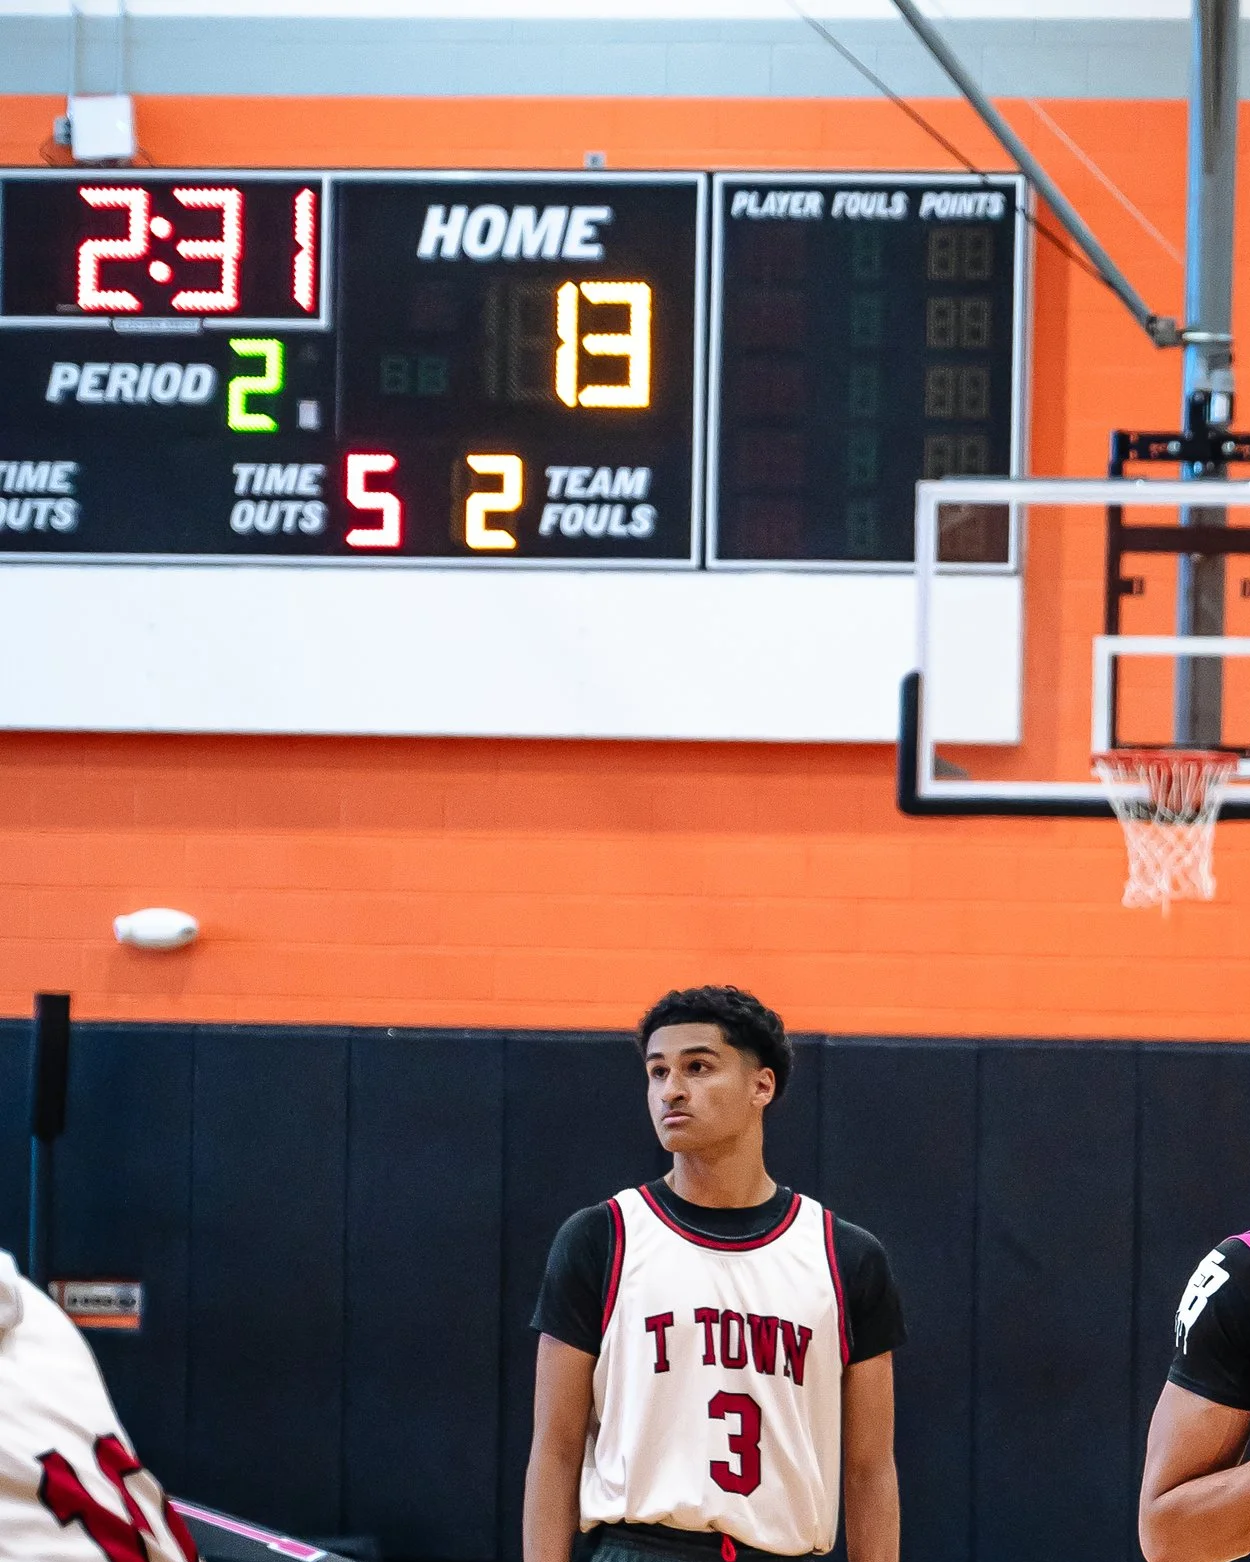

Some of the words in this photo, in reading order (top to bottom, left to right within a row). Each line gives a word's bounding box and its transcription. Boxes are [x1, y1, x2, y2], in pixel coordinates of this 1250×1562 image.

[416, 203, 616, 262] HOME
[730, 189, 825, 220] PLAYER
[830, 189, 909, 220] FOULS
[918, 190, 1006, 220] POINTS
[78, 186, 317, 313] 2:31
[556, 280, 653, 410] 13
[45, 361, 215, 403] PERIOD
[228, 337, 286, 434] 2
[232, 462, 328, 497] TIME
[346, 453, 404, 549] 5
[464, 453, 525, 551] 2
[544, 465, 653, 500] TEAM
[0, 497, 82, 533] UTS
[229, 499, 329, 535] OUTS
[538, 502, 660, 538] FOULS
[644, 1310, 676, 1374] T
[694, 1306, 813, 1386] TOWN
[707, 1390, 763, 1498] 3
